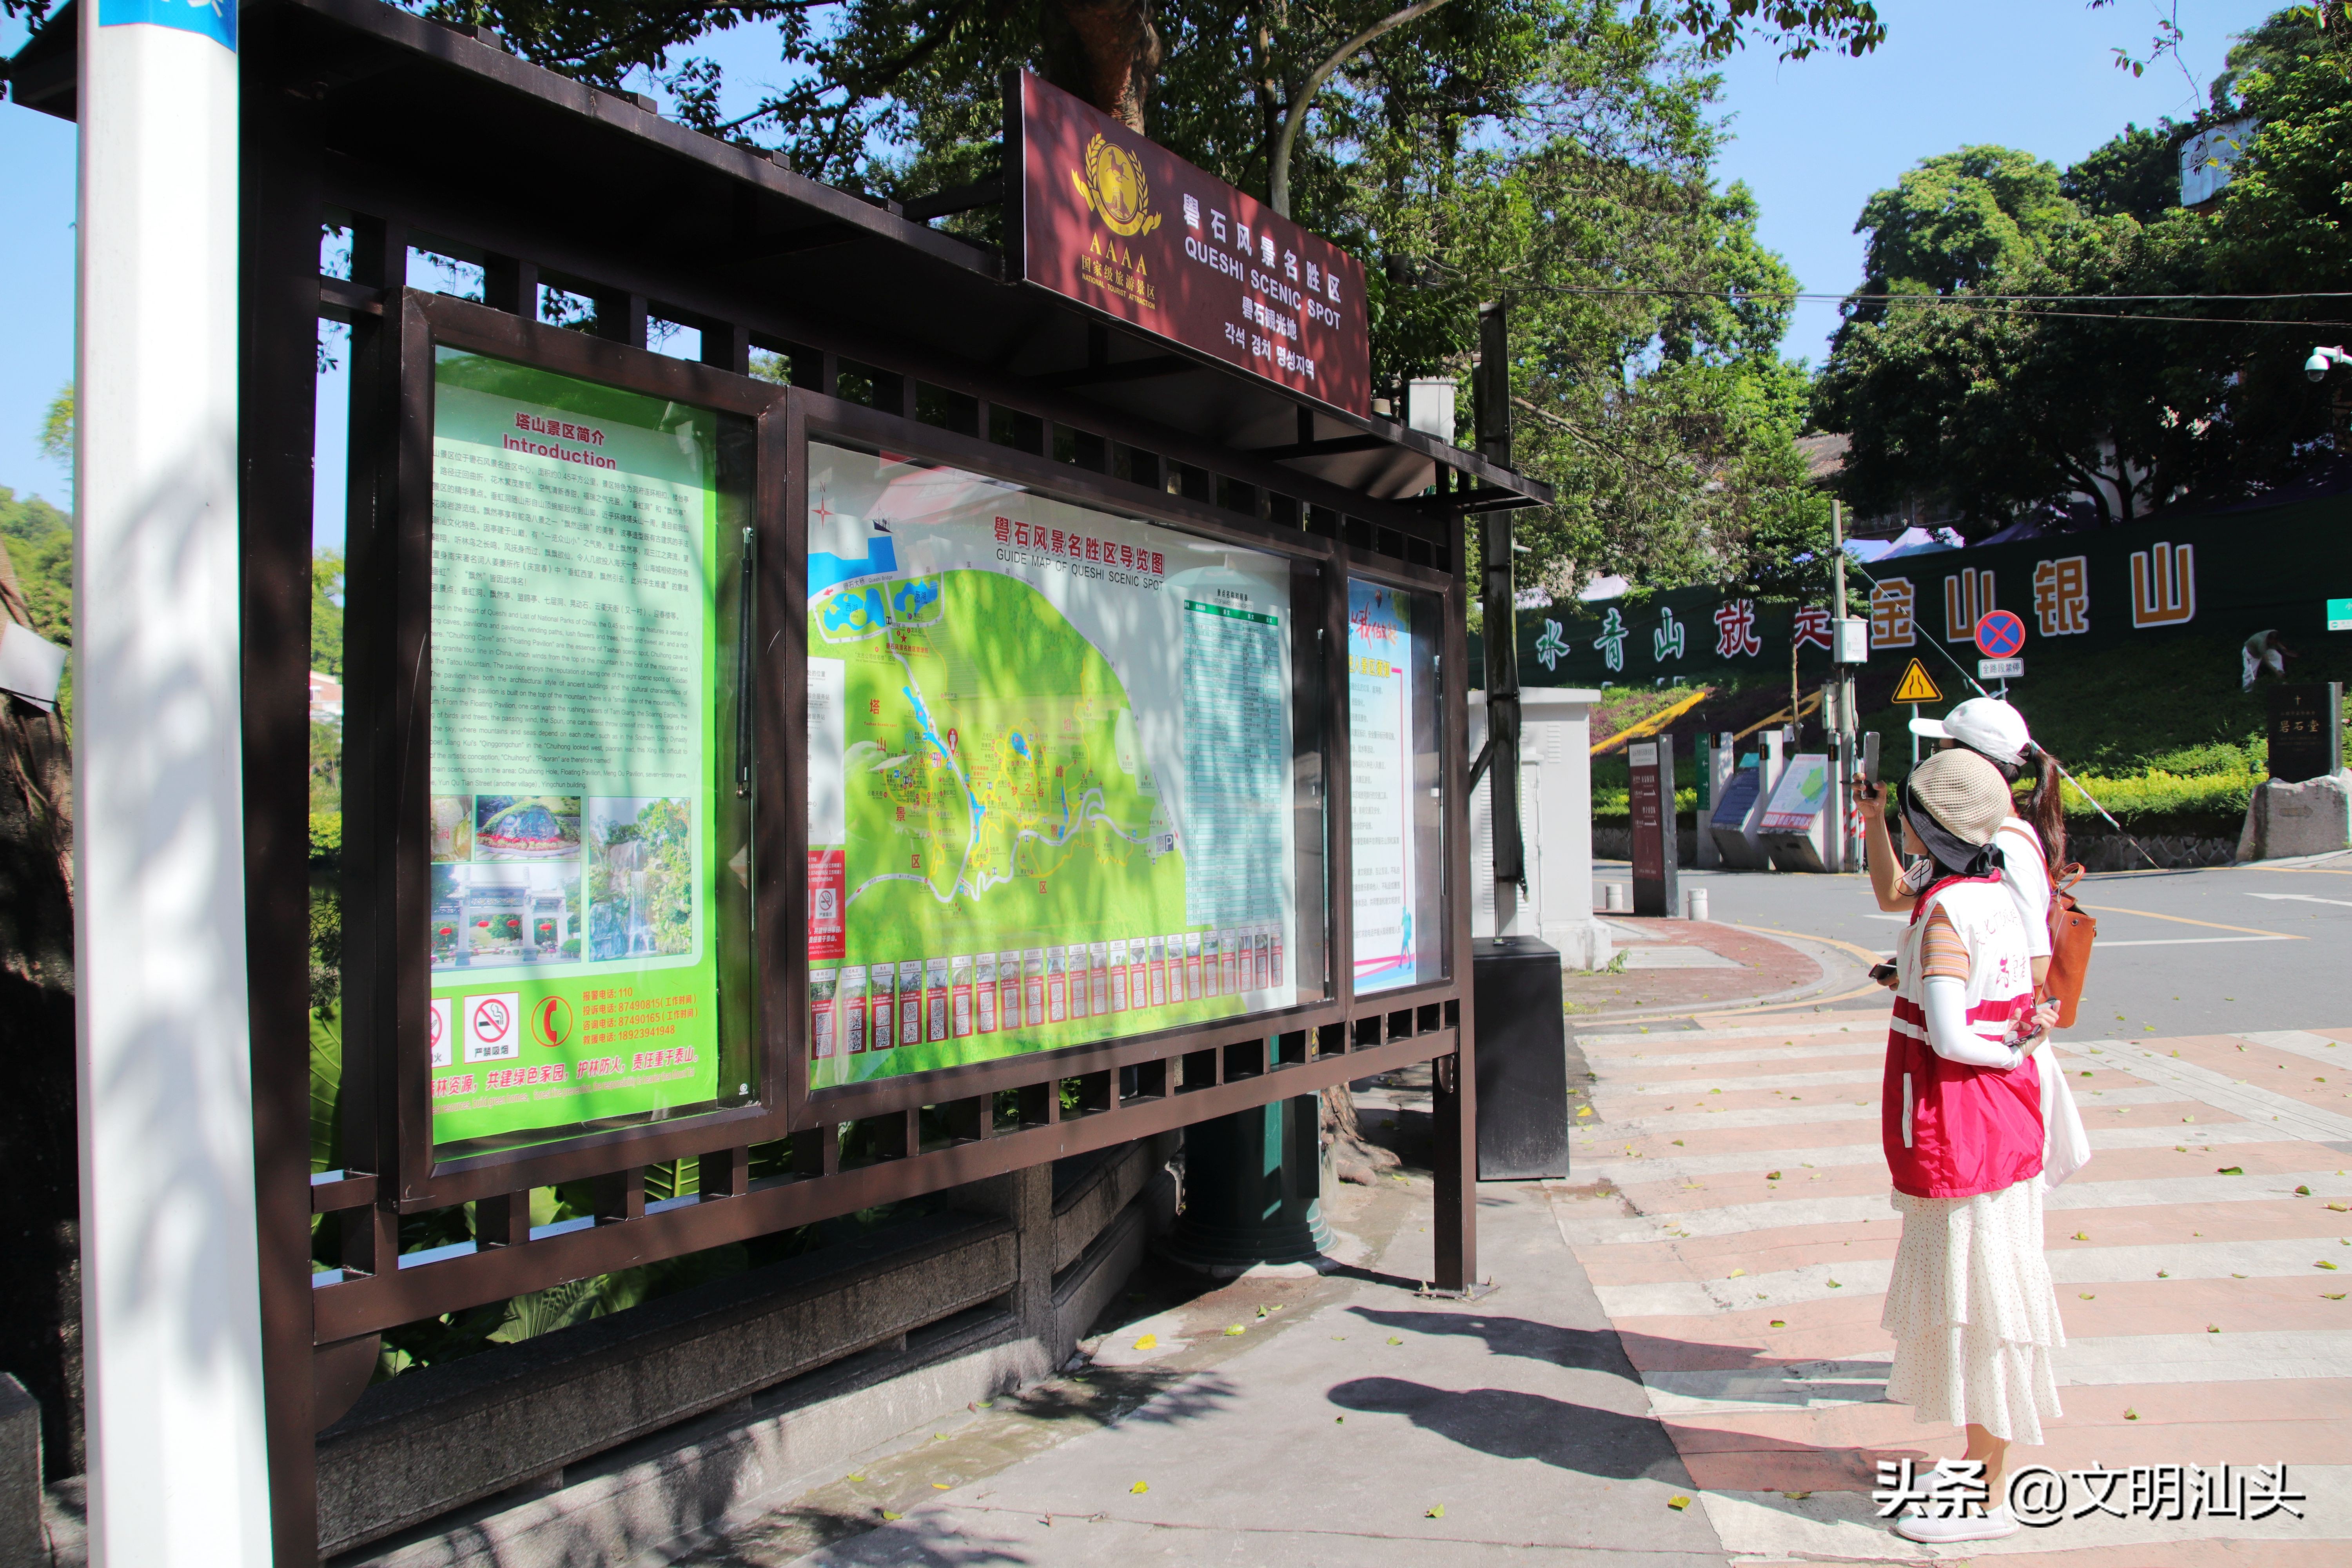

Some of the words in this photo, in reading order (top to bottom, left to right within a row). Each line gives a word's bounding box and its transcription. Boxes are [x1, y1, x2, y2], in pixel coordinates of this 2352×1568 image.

[1082, 254, 1155, 301] 国家级旅游景区
[1082, 273, 1105, 289] NATIONAL
[1107, 282, 1126, 298] TOURIST
[1128, 291, 1155, 309] ATTRACTION
[1185, 237, 1244, 282] QUESHI
[1251, 269, 1301, 310] SCENIC
[1307, 298, 1341, 330] SPOT
[1225, 321, 1245, 348] 각석
[1252, 334, 1271, 361] 경치
[1277, 347, 1314, 380] 명성지역
[515, 413, 605, 446] 塔山景区简介
[503, 434, 616, 470] Introduction
[819, 481, 826, 493] N
[996, 548, 1027, 565] GUIDE
[1032, 555, 1051, 569] MAP
[1055, 560, 1067, 572] OF
[1071, 563, 1104, 580] QUESHI
[1109, 571, 1139, 586] SCENIC
[1143, 577, 1163, 592] SPOT
[845, 602, 858, 612] 西湖
[915, 590, 926, 600] 东湖
[487, 608, 506, 617] Queshi
[537, 614, 558, 622] National
[582, 618, 597, 627] China,
[646, 626, 664, 634] features
[638, 649, 649, 658] spot.
[650, 650, 671, 661] Chuihong
[1984, 662, 2020, 674] 全路段禁停
[869, 699, 880, 715] 塔
[877, 736, 886, 752] 山
[896, 807, 906, 821] 景
[911, 854, 920, 868] 区
[618, 987, 632, 997] 110
[618, 1025, 675, 1042] 18923941948
[474, 1045, 508, 1058] 严禁吸烟
[473, 1097, 487, 1108] build
[489, 1096, 505, 1109] green
[534, 1088, 552, 1100] forest
[593, 1082, 602, 1091] the
[602, 1077, 637, 1091] responsibility
[637, 1076, 642, 1085] is
[661, 1071, 672, 1082] than
[673, 1069, 688, 1079] Mount
